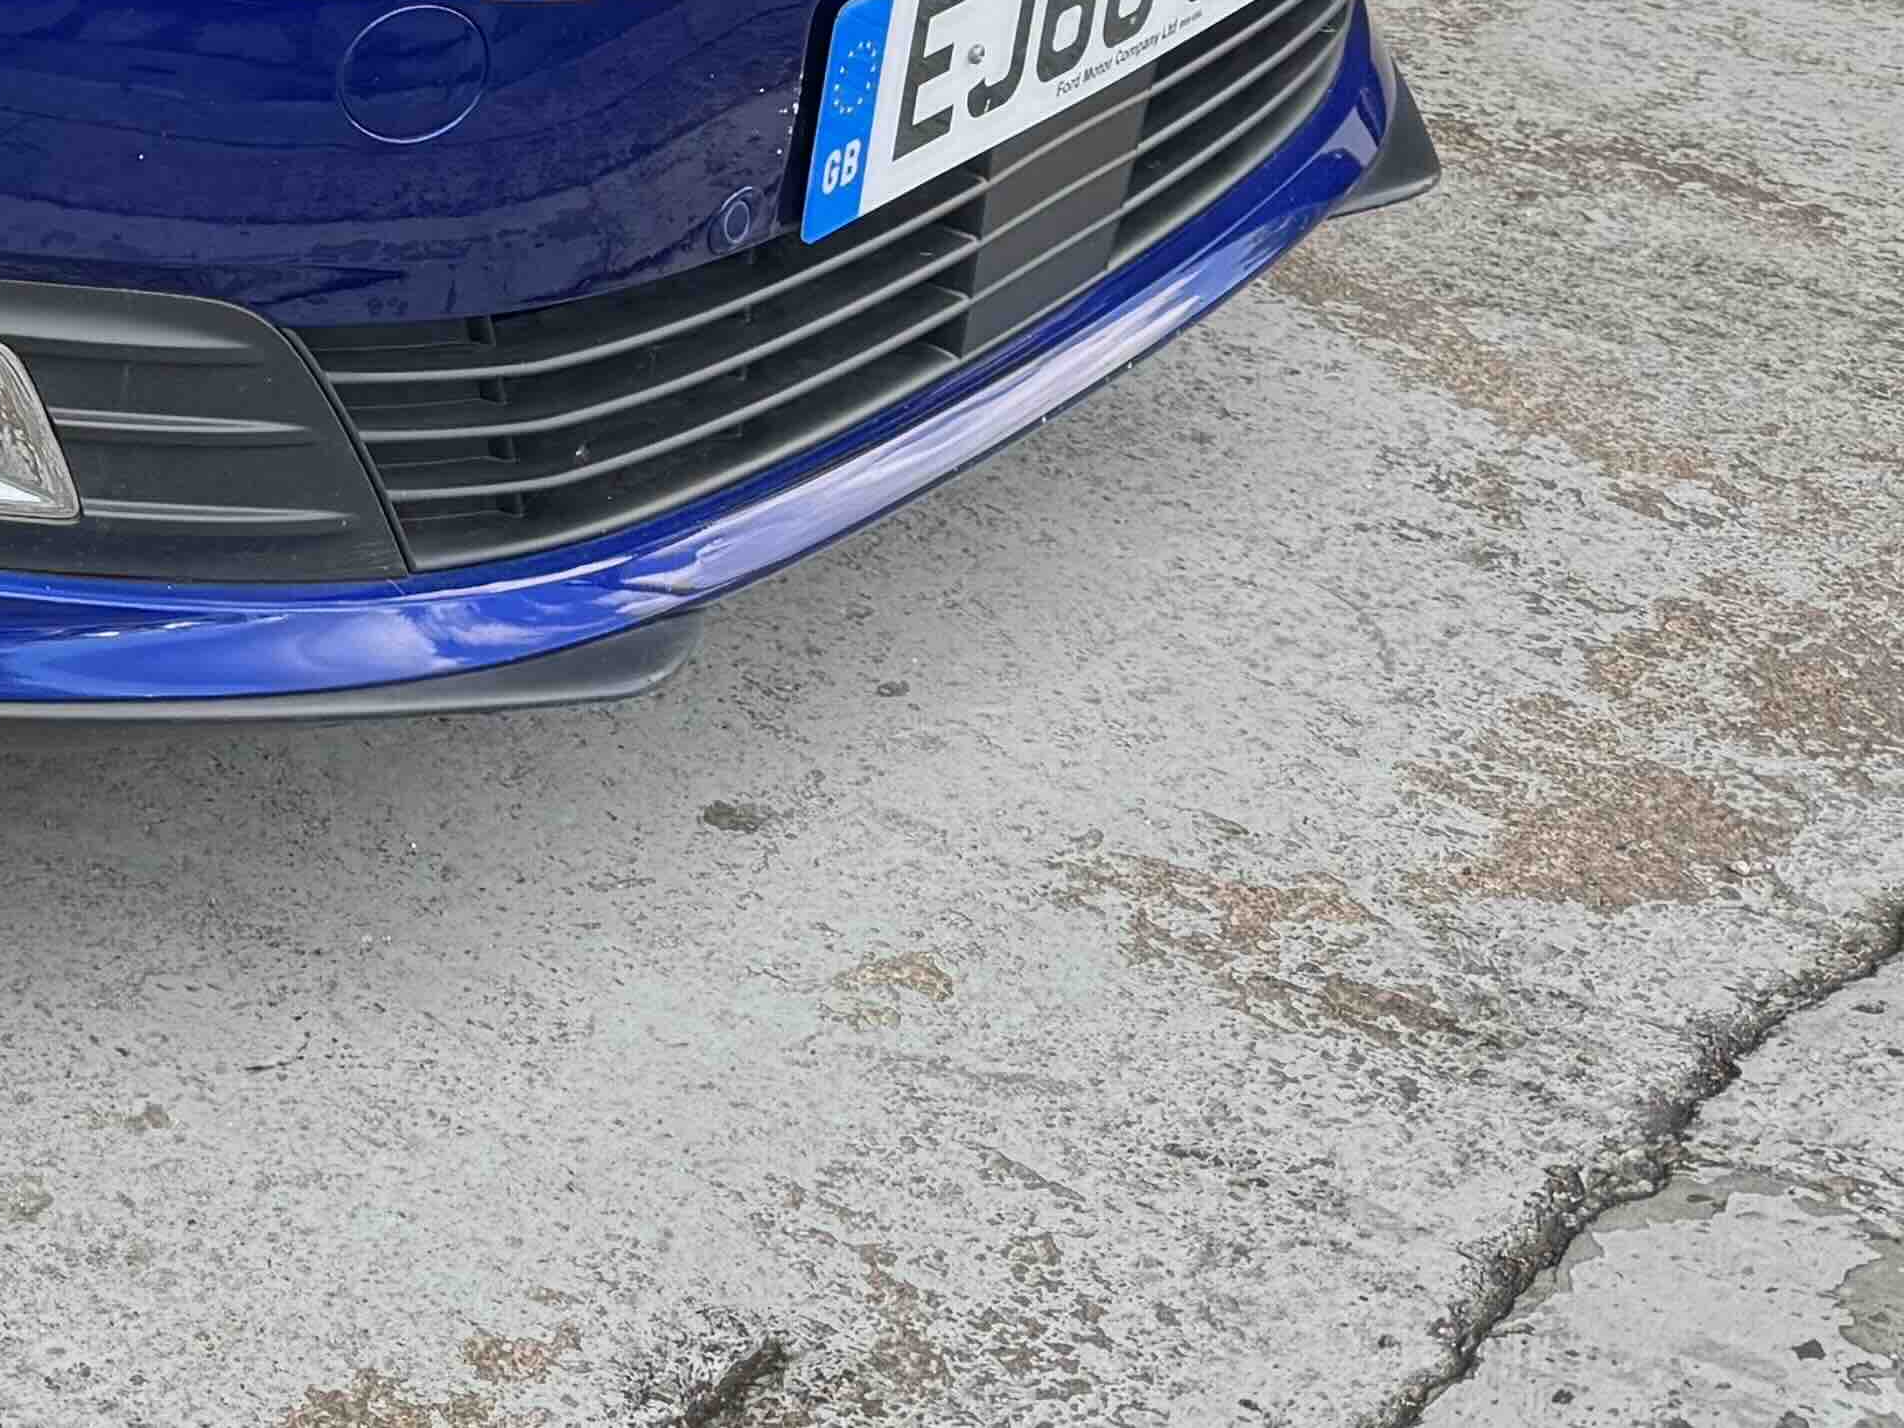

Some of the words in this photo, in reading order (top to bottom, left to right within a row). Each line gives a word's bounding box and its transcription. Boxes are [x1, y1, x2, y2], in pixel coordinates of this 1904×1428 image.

[1056, 73, 1082, 97] Ford
[1083, 56, 1114, 82] Motor
[1115, 31, 1160, 65] Company
[821, 137, 862, 196] GB
